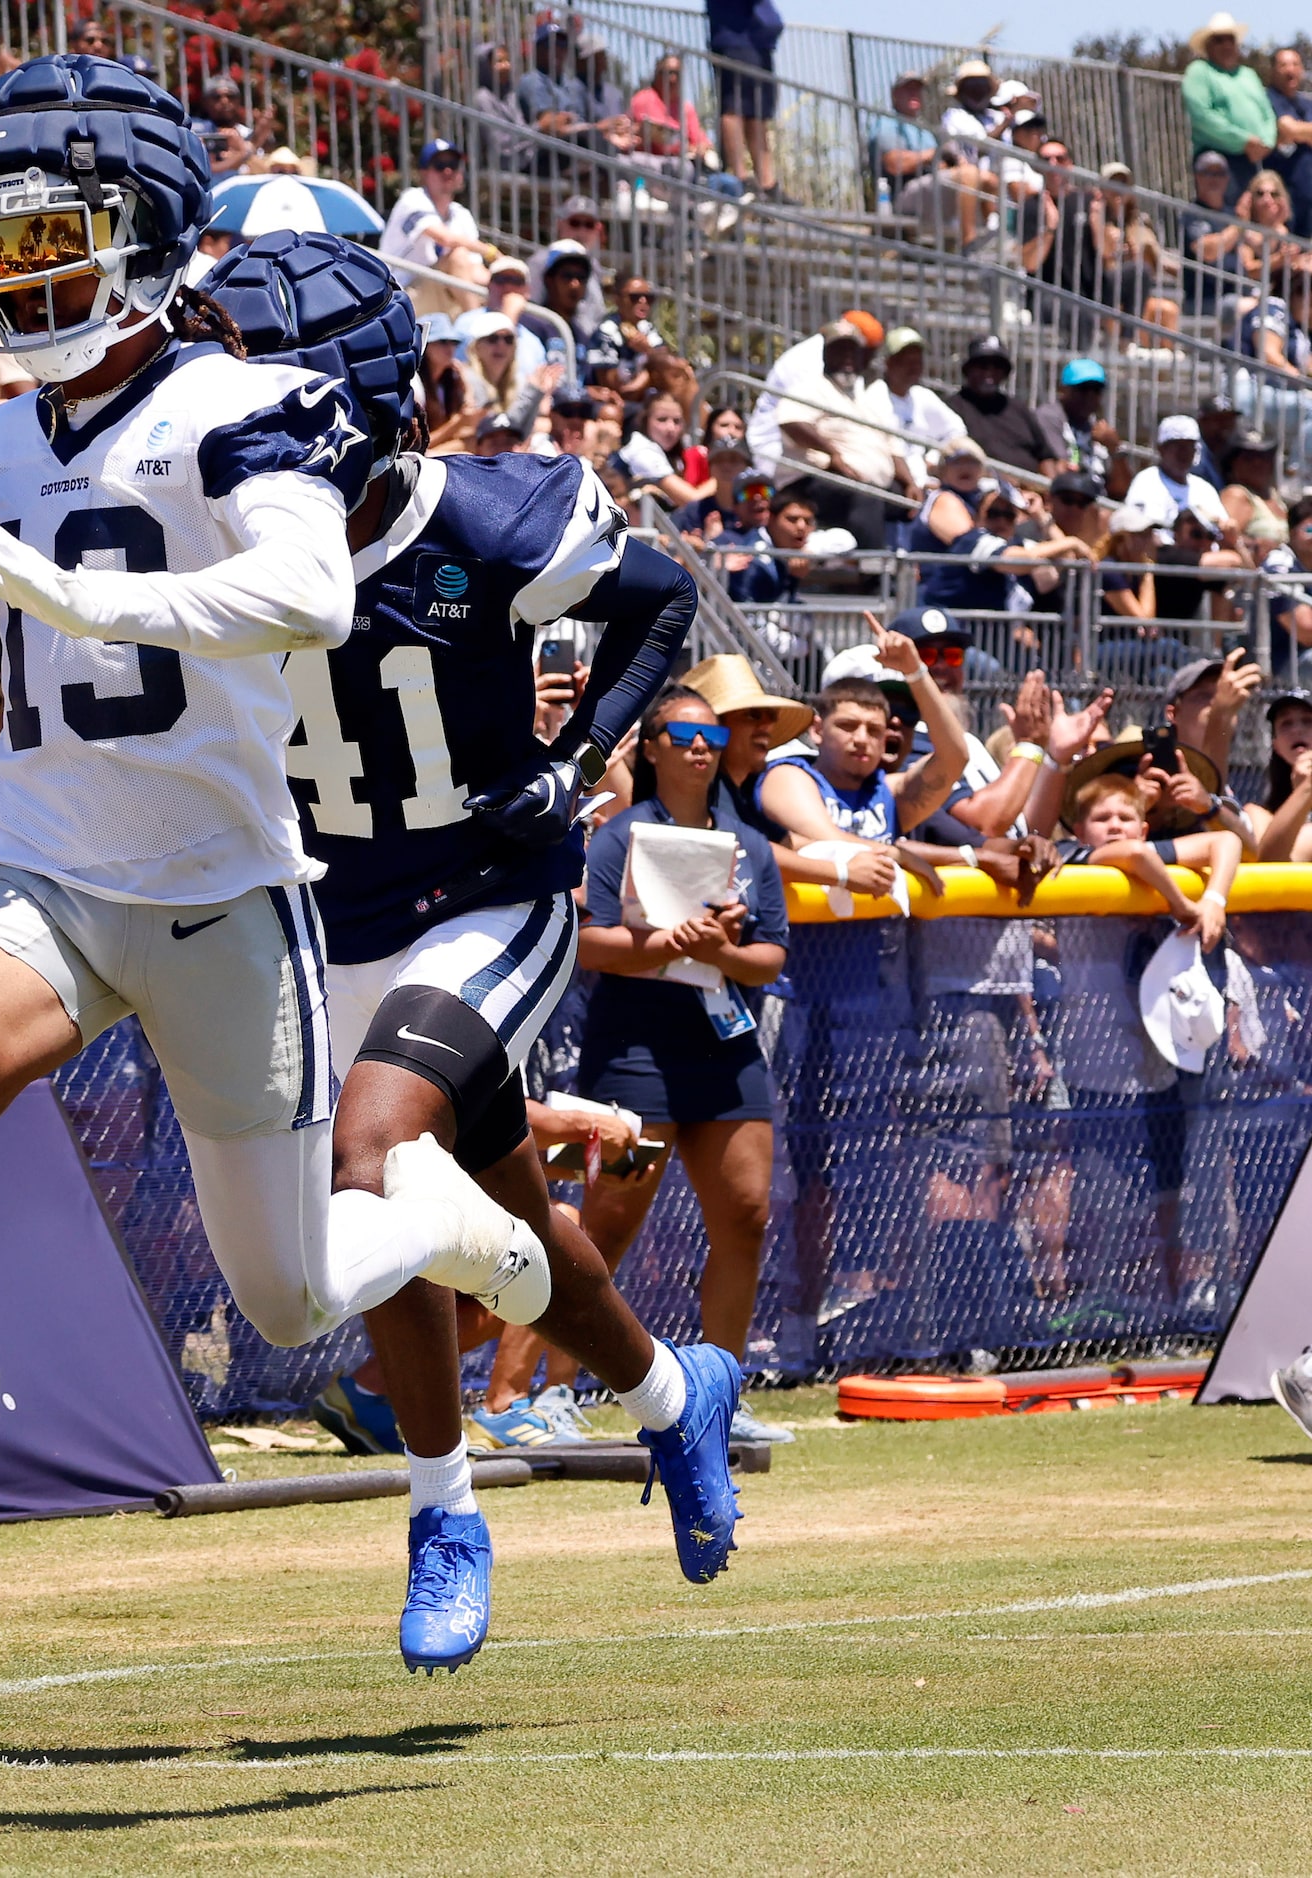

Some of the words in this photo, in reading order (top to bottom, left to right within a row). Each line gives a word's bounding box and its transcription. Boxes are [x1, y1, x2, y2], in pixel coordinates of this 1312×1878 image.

[135, 459, 172, 476] AT&T
[40, 476, 90, 497] COWBOYS
[427, 602, 472, 619] AT&T
[281, 645, 473, 840] 41
